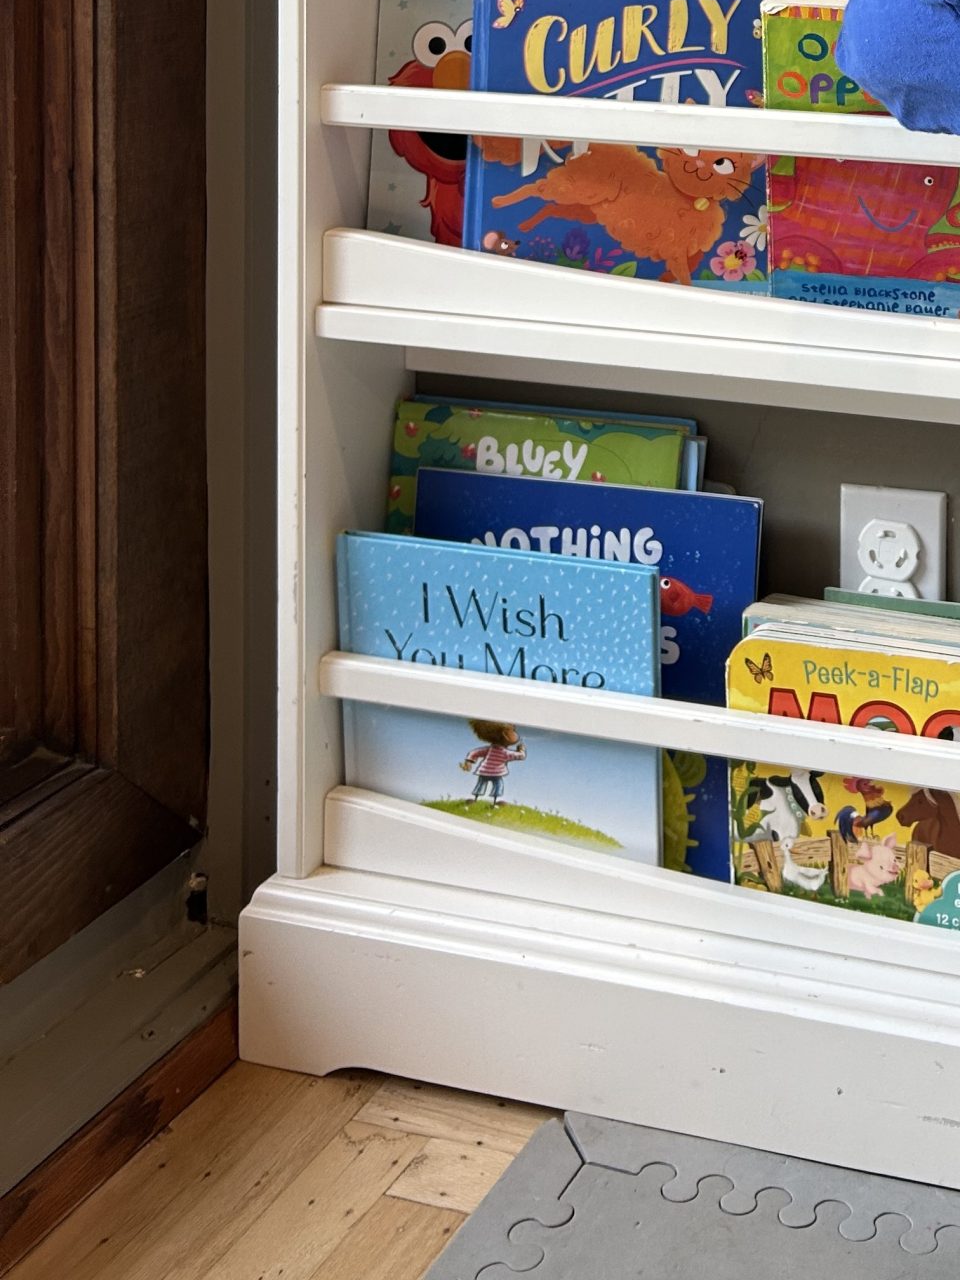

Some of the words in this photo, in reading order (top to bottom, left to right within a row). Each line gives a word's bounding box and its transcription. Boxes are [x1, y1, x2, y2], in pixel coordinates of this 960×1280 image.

[476, 436, 588, 480] BLUEY
[422, 582, 430, 623] I
[446, 585, 569, 641] Wish
[803, 659, 939, 703] Peek-a-Flap
[936, 913, 949, 925] 12
